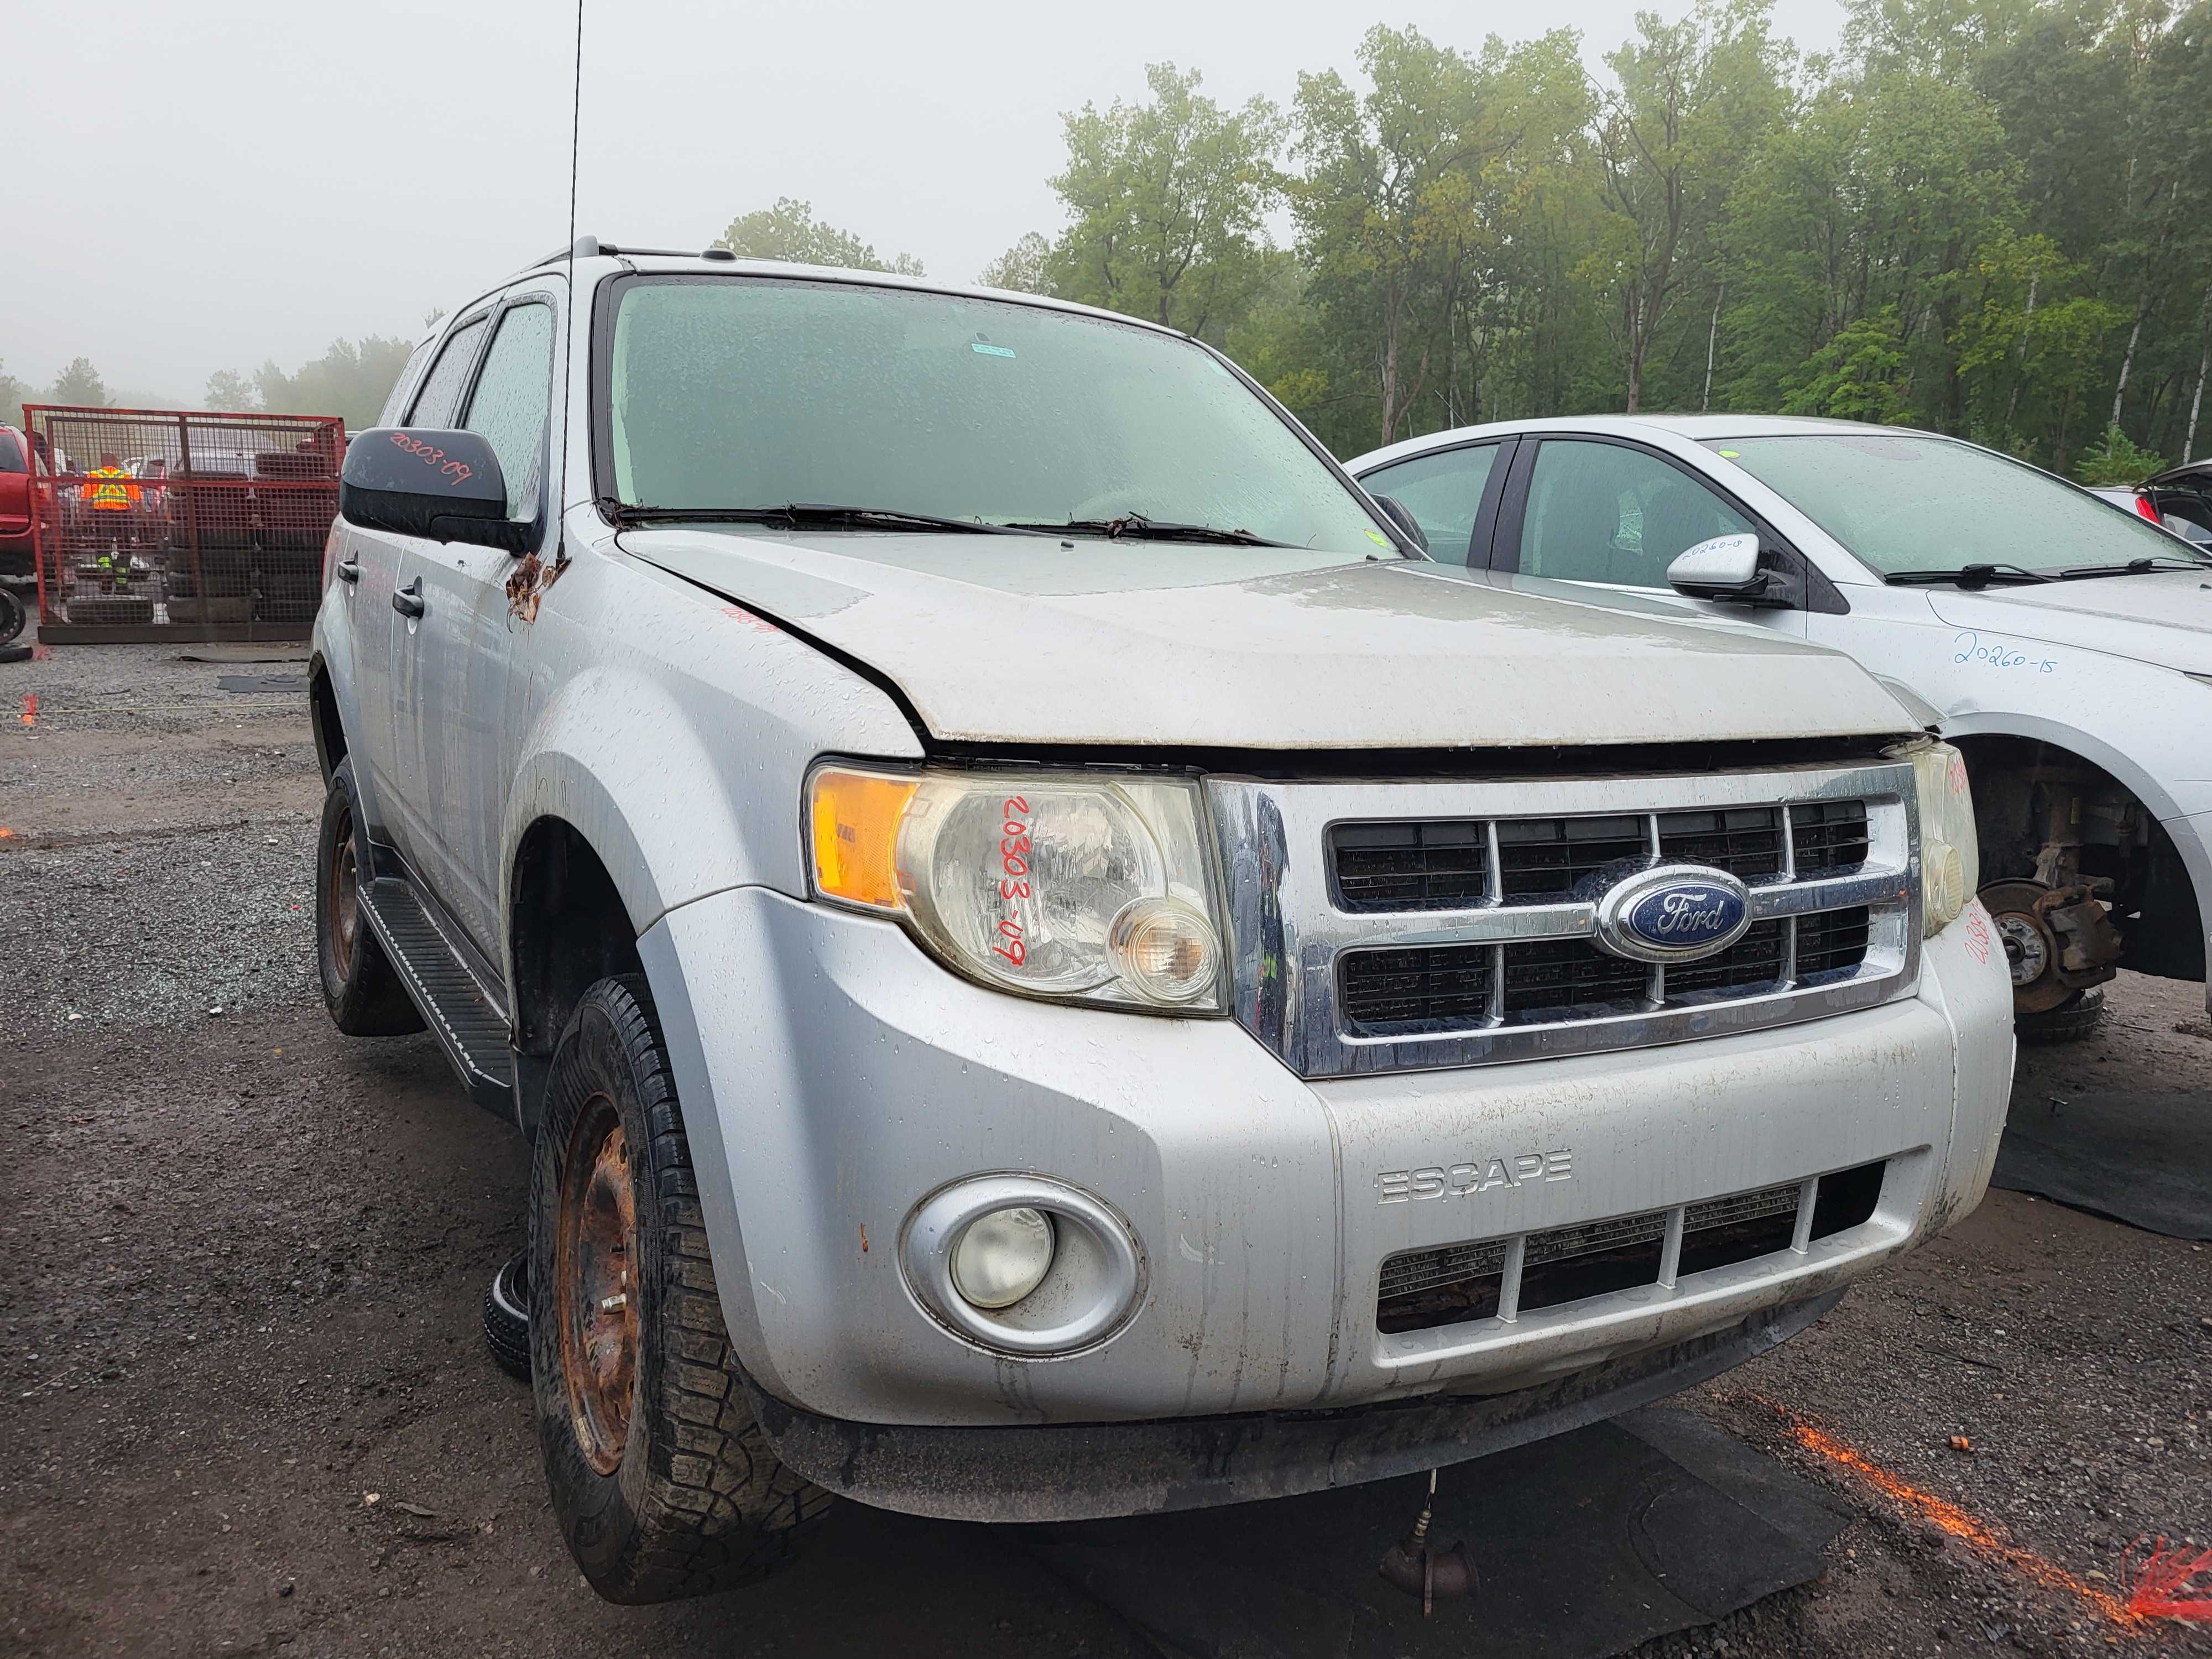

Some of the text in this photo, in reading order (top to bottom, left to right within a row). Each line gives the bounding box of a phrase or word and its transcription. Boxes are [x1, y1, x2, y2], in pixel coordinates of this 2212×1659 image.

[1954, 632, 2058, 673] 20260-15
[992, 796, 1031, 966] 20303-09
[1657, 893, 1724, 935] Ford
[1377, 1149, 1572, 1204] ESCAPE
